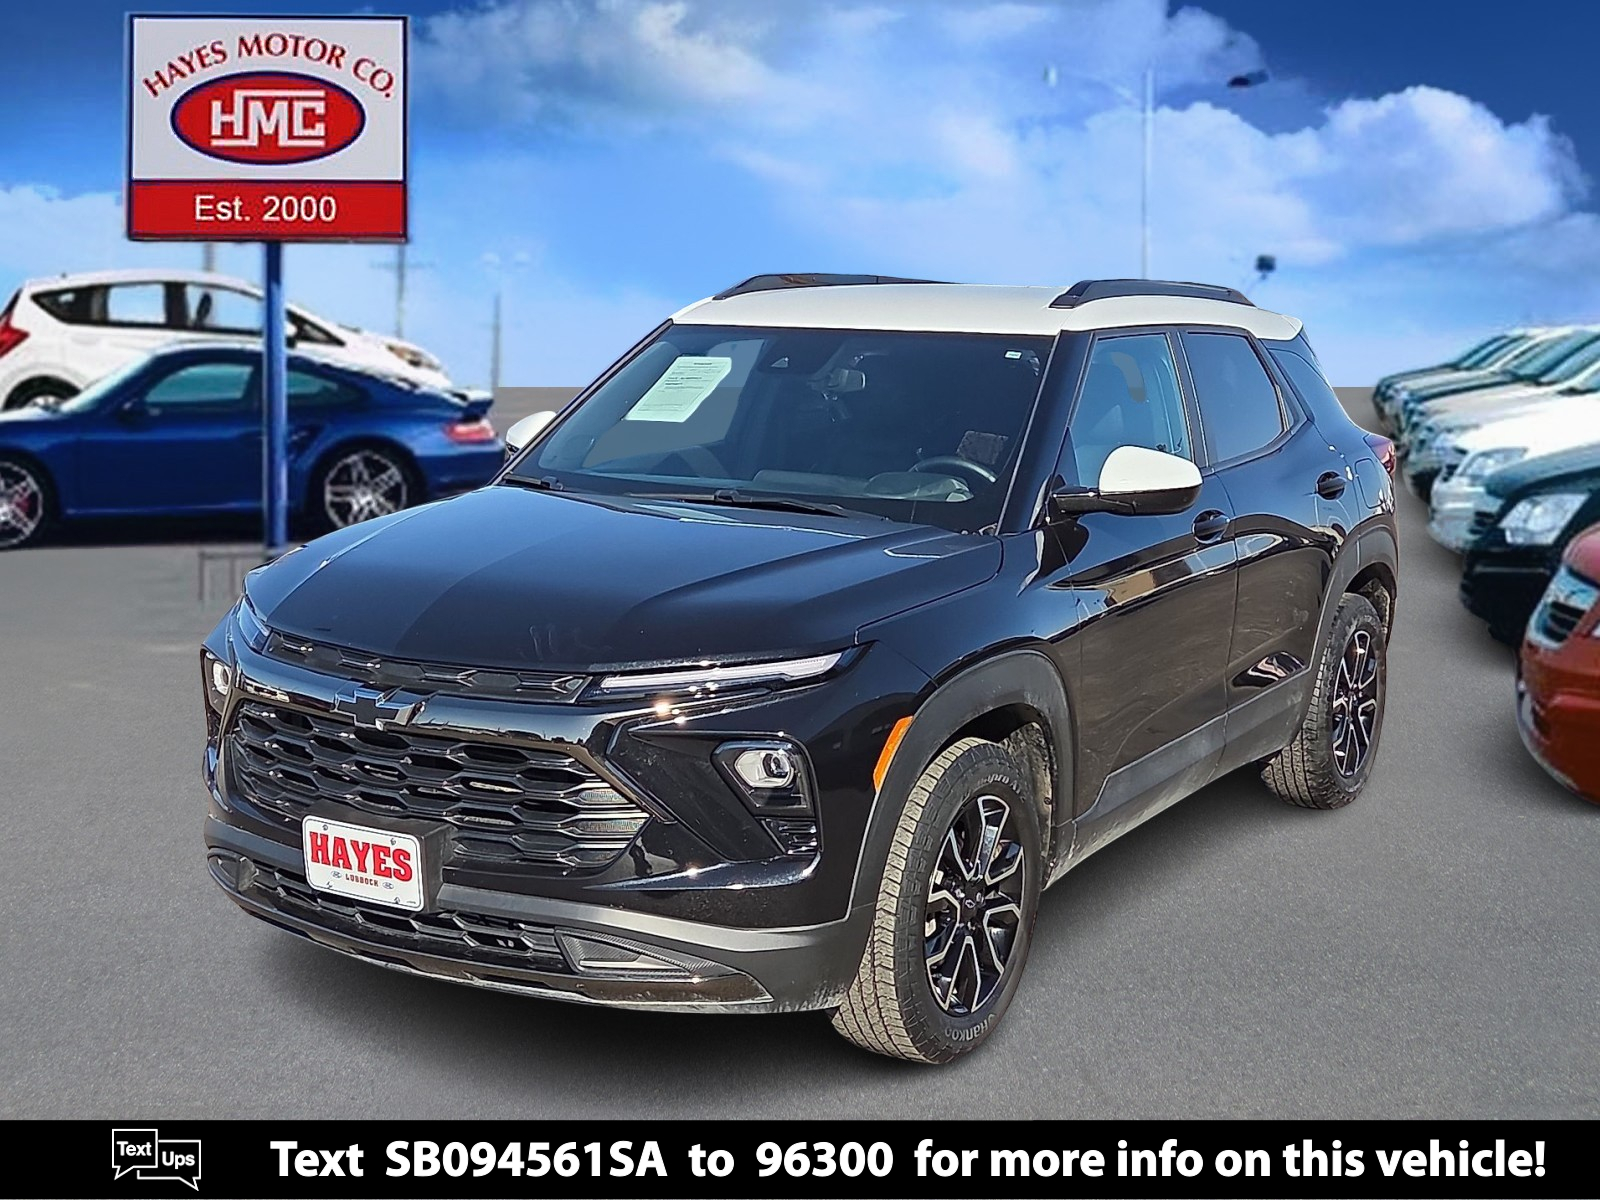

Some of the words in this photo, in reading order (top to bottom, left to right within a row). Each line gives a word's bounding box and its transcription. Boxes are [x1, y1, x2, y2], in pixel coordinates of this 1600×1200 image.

[142, 40, 228, 98] HAYES
[237, 33, 347, 70] MOTOR
[352, 57, 395, 99] CO.
[210, 89, 327, 147] HMC
[194, 195, 250, 222] Est.
[262, 195, 337, 222] 2000
[309, 831, 413, 882] HAYES
[943, 1018, 989, 1042] Hankoo
